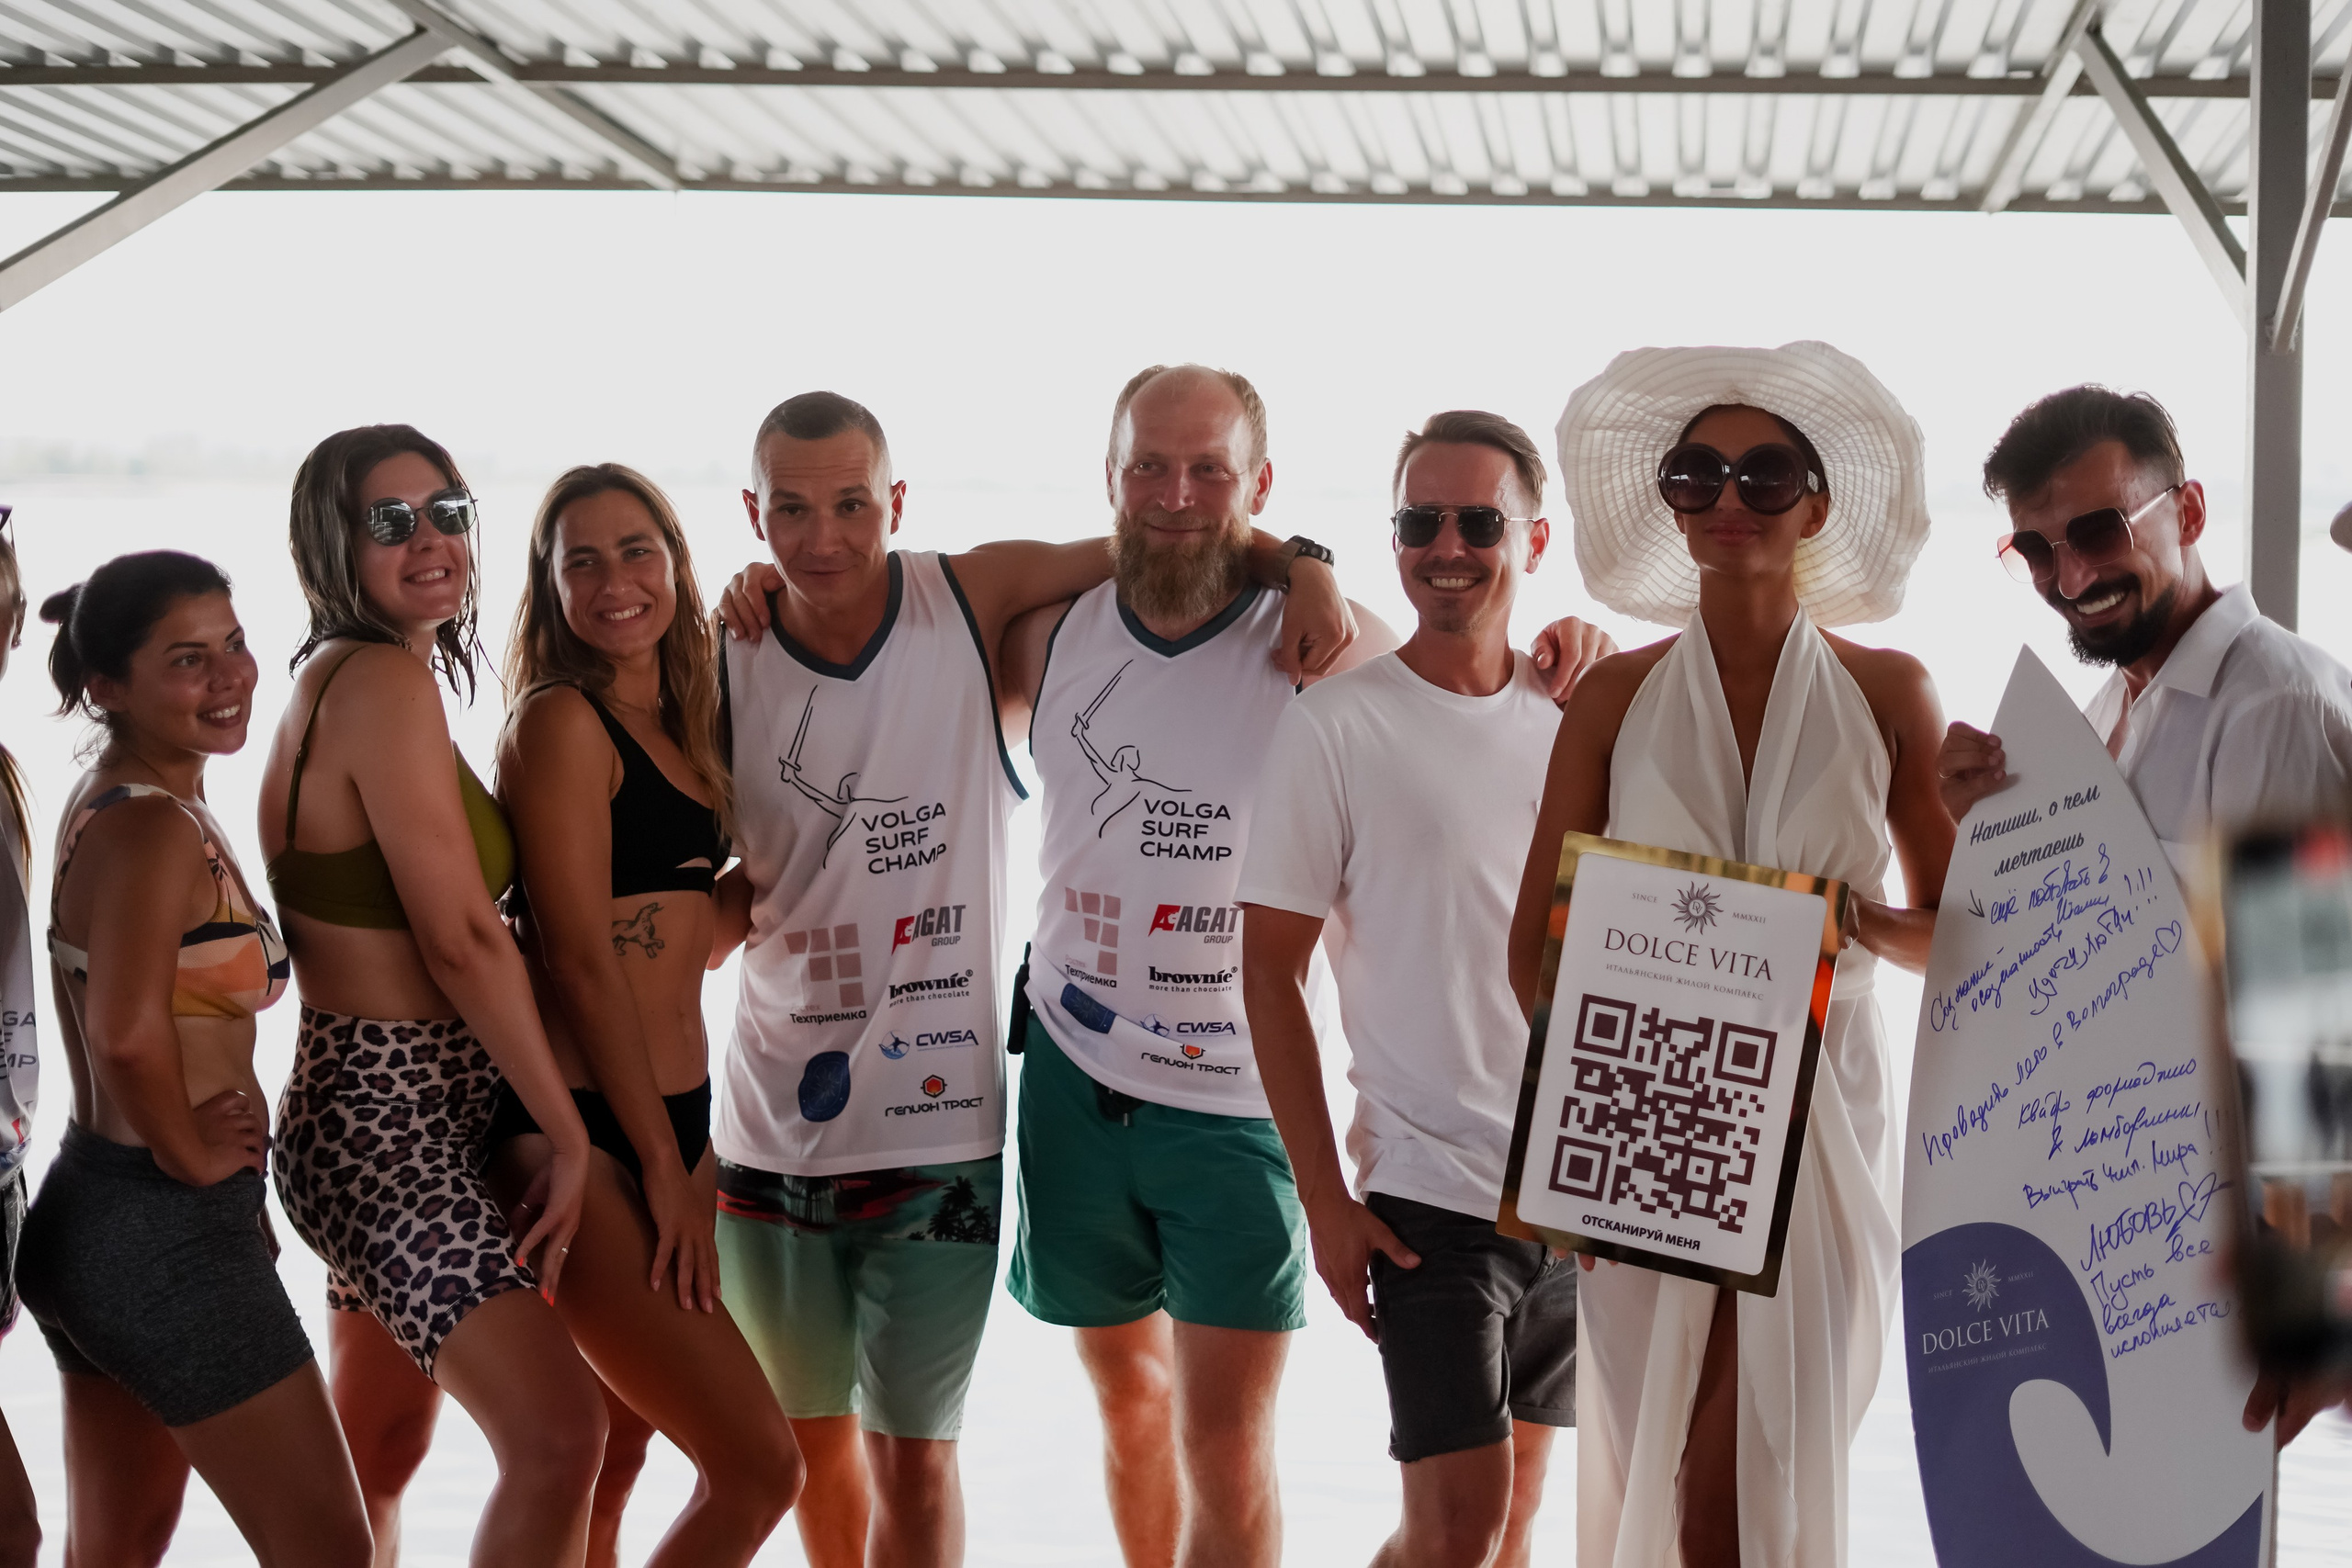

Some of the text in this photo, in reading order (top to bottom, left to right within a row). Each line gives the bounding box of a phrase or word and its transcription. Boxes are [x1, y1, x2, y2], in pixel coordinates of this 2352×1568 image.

[861, 802, 946, 832] VOLGA
[1144, 798, 1231, 820] VOLGA
[1970, 784, 2100, 846] Напиши, о чем
[865, 827, 929, 853] SURF
[1141, 820, 1209, 839] SURF
[868, 843, 947, 874] CHAMP
[1140, 841, 1232, 861] CHAMP
[1994, 832, 2085, 876] мечтаешь
[1632, 893, 1658, 903] SINCE
[1175, 906, 1240, 933] AGAT
[1732, 912, 1766, 924] MMXXII
[931, 936, 961, 947] GROUP
[1204, 935, 1233, 944] GROUP
[1604, 928, 1772, 981] DOLCE VITA
[1065, 964, 1117, 987] Техприемка
[1606, 964, 1764, 1000] ИТАЛЬЯНСКИЙ ЖИЛОЙ КОМПЛЕКС
[889, 998, 904, 1008] more
[928, 990, 969, 999] chocolate
[790, 1010, 866, 1025] Техприемка
[1176, 1021, 1236, 1035] CWSA
[916, 1030, 978, 1046] CWSA
[1581, 1214, 1701, 1250] ОТСКАНИРУЙ МЕНЯ
[1933, 1289, 1952, 1300] SINCE
[2090, 1263, 2154, 1311] Пусть
[1922, 1308, 2050, 1355] DOLCE VITA
[1928, 1343, 2047, 1373] ИТАЛЬЯНСКИЙ ЖИЛОЙ КОМПЛЕКС
